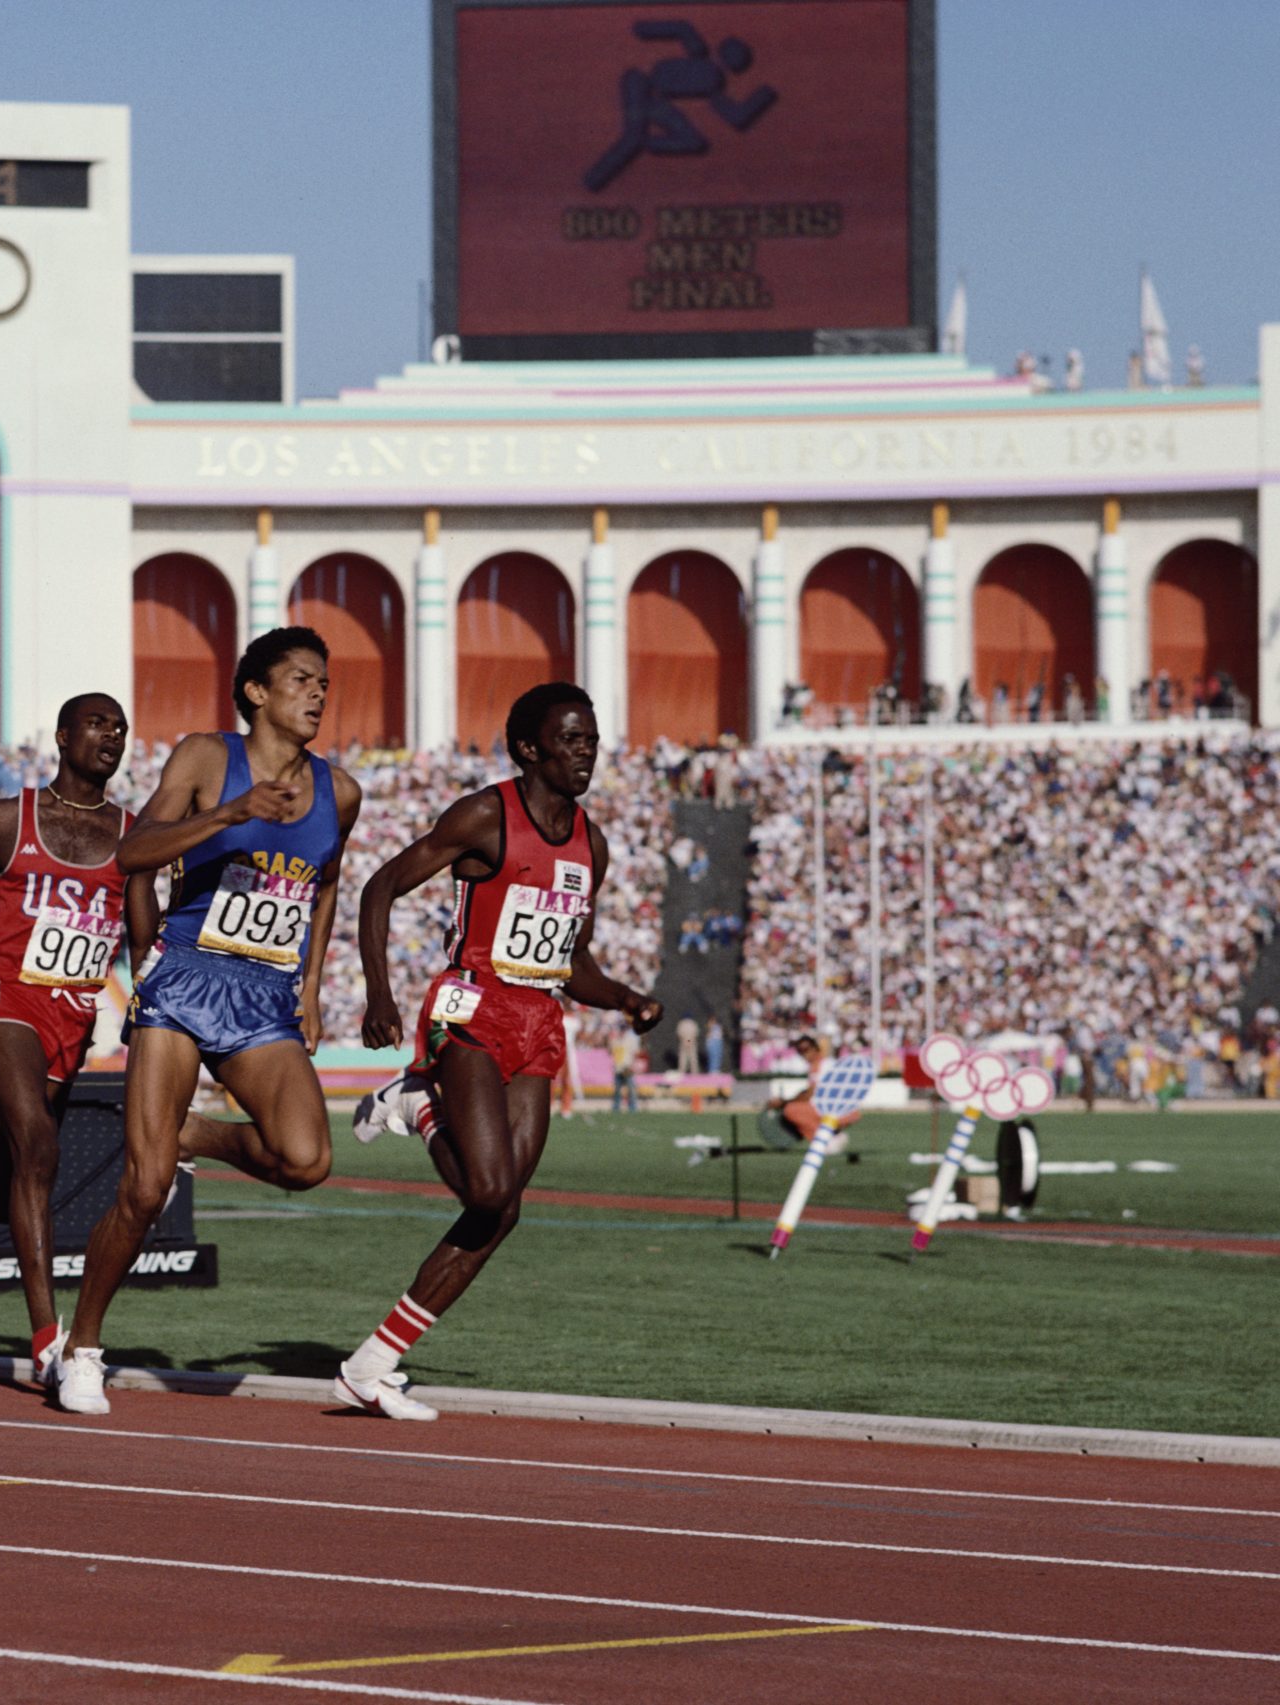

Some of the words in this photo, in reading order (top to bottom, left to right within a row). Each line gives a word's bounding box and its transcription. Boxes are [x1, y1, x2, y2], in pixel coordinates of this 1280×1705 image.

[565, 208, 637, 239] 800
[658, 205, 840, 238] METERS
[649, 242, 754, 273] MEN
[633, 278, 771, 309] FINAL
[196, 435, 300, 477] LOS
[325, 433, 601, 477] ANGELES
[657, 429, 1026, 474] CALIFORNIA
[1065, 422, 1180, 467] 1984
[22, 872, 108, 919] USA
[218, 891, 302, 946] 093
[506, 912, 578, 964] 584
